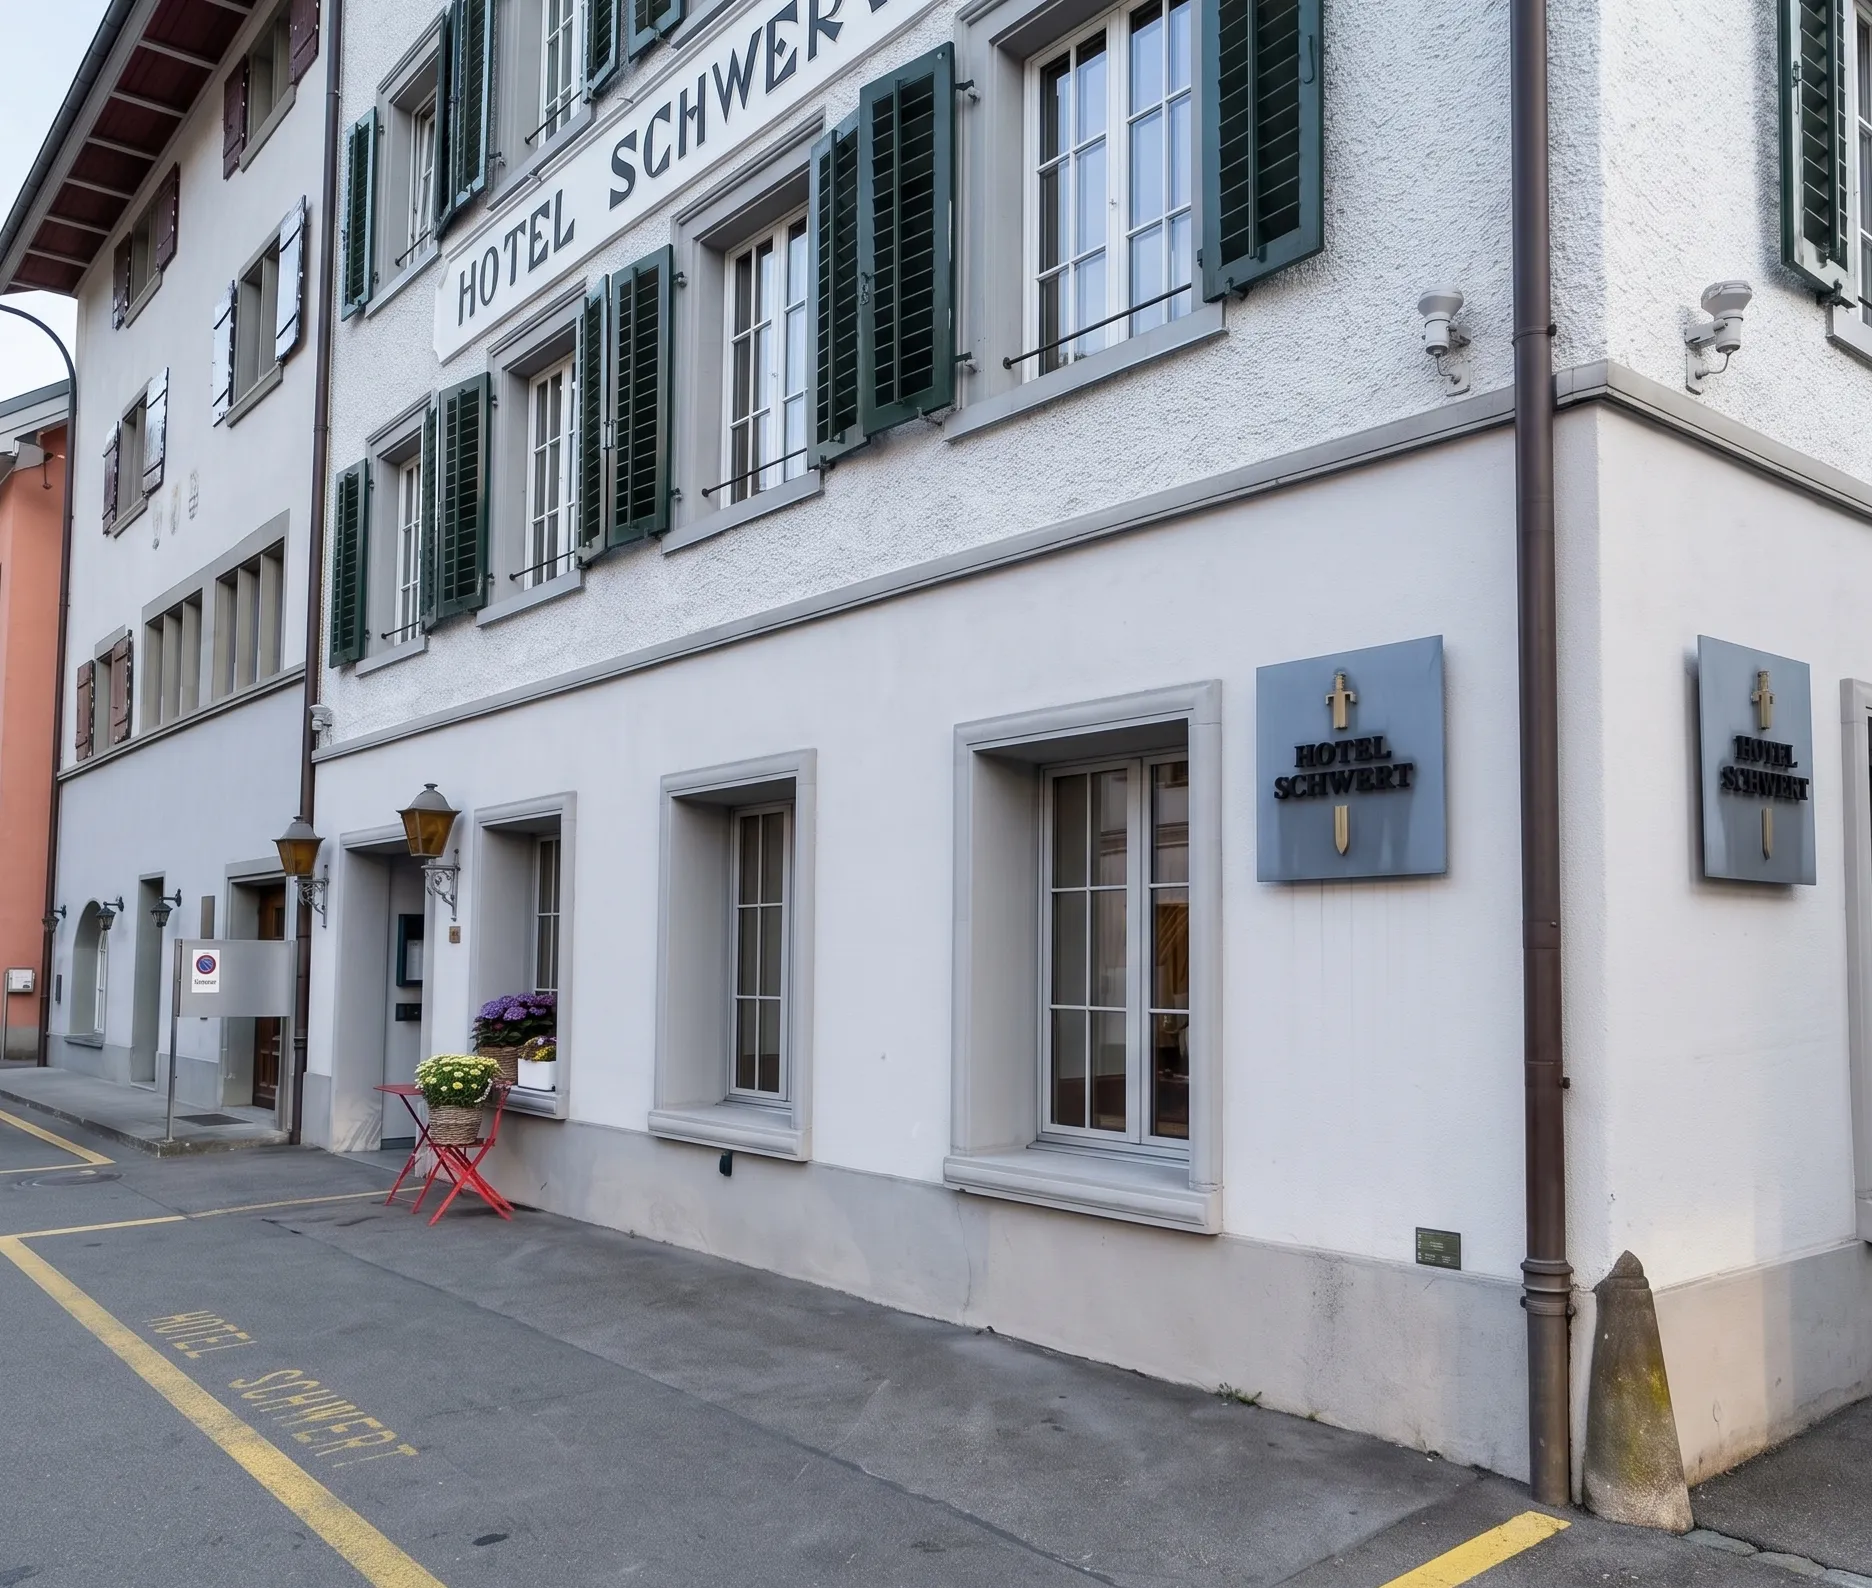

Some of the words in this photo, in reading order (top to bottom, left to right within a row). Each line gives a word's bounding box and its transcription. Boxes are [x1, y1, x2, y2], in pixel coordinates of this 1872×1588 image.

[457, 188, 576, 327] HOTEL
[608, 0, 888, 210] SCHWER
[1293, 735, 1392, 768] HOTEL
[1733, 735, 1799, 768] HOTEL
[1273, 763, 1414, 800] SCHWERT
[1720, 765, 1810, 801] SCHWERT
[142, 1310, 258, 1360] HOTEL
[228, 1369, 419, 1468] SCHWERT
